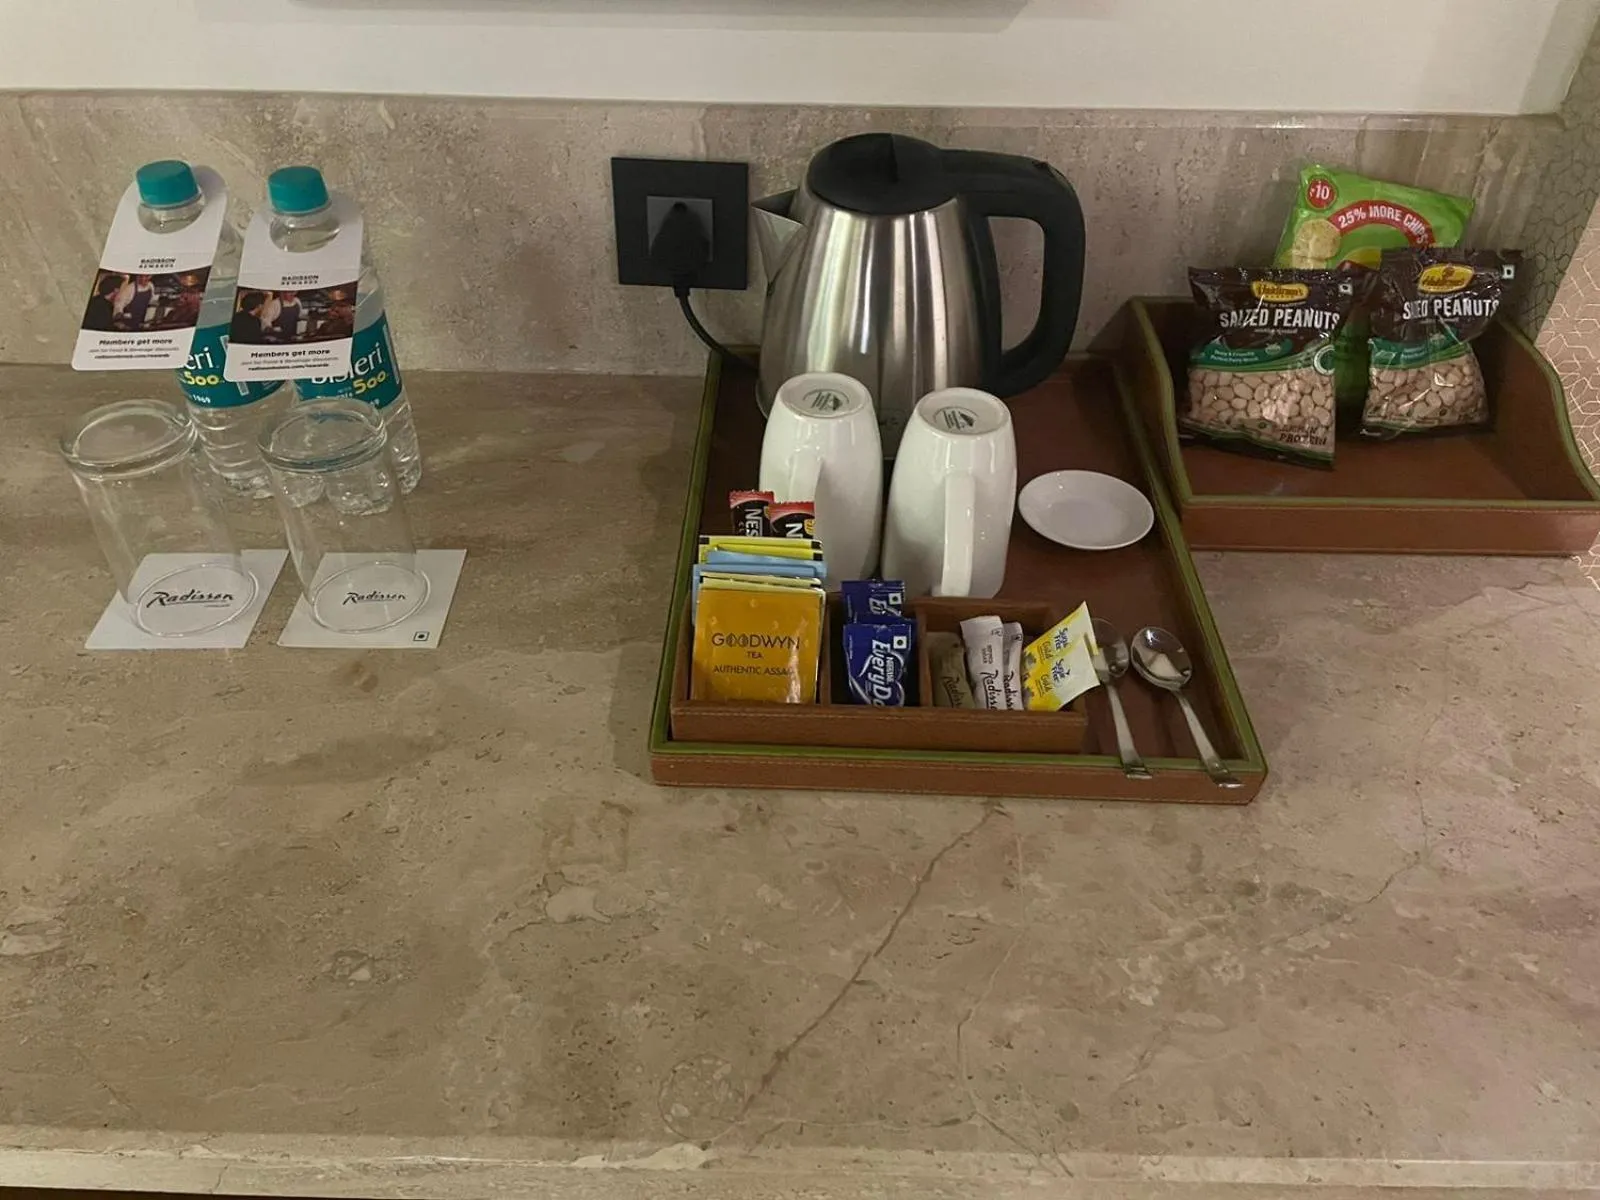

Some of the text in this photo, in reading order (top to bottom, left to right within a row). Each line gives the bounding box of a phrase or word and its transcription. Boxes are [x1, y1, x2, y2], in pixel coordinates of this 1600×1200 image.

[1338, 208, 1366, 229] 25%
[1369, 205, 1402, 222] MORE
[1433, 298, 1499, 318] PEANUTS
[1219, 308, 1340, 330] SALTED PEANUTS
[251, 350, 290, 358] Members
[291, 350, 306, 358] get
[183, 371, 220, 386] 500
[353, 371, 387, 394] 500
[146, 588, 235, 608] Radisson
[342, 591, 407, 606] Radisson
[711, 632, 801, 650] GOODWYN
[746, 651, 763, 659] TEA
[714, 664, 760, 675] AUTHENTIC
